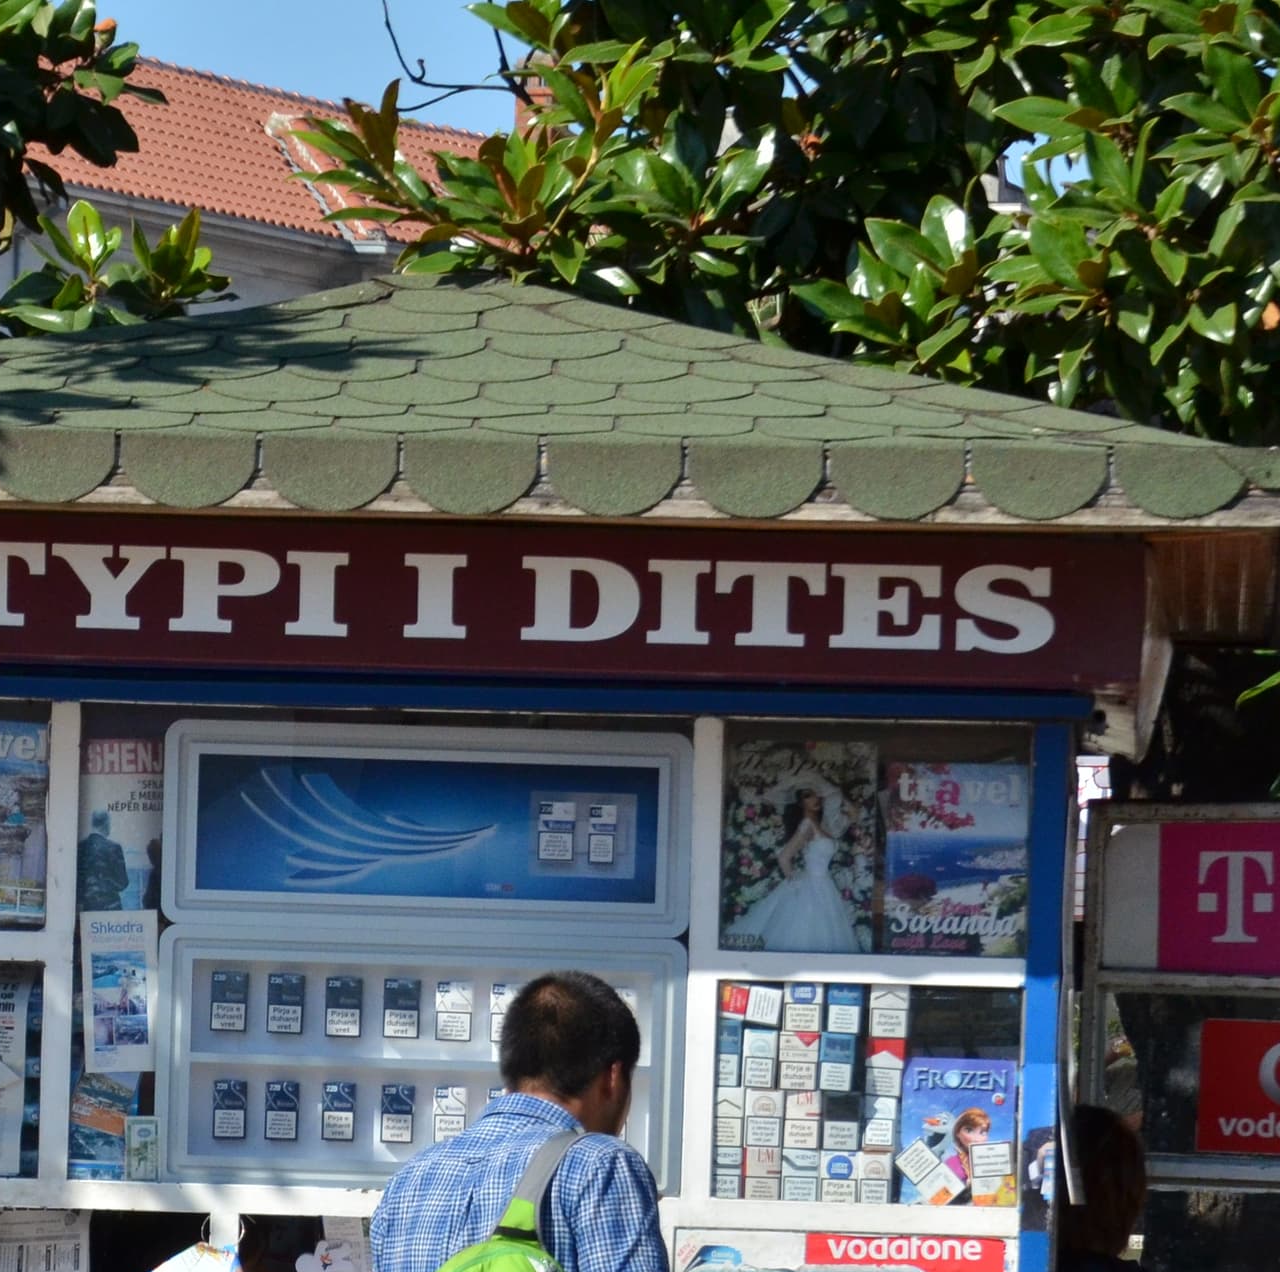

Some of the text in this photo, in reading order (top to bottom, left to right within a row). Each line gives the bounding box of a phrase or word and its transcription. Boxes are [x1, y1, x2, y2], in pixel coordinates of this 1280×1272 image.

[402, 553, 468, 639] I
[521, 555, 1056, 654] DITES
[898, 772, 1021, 805] travel
[90, 921, 144, 935] Shkodra
[890, 904, 1018, 937] Saranda
[912, 1067, 1009, 1092] FROZEN
